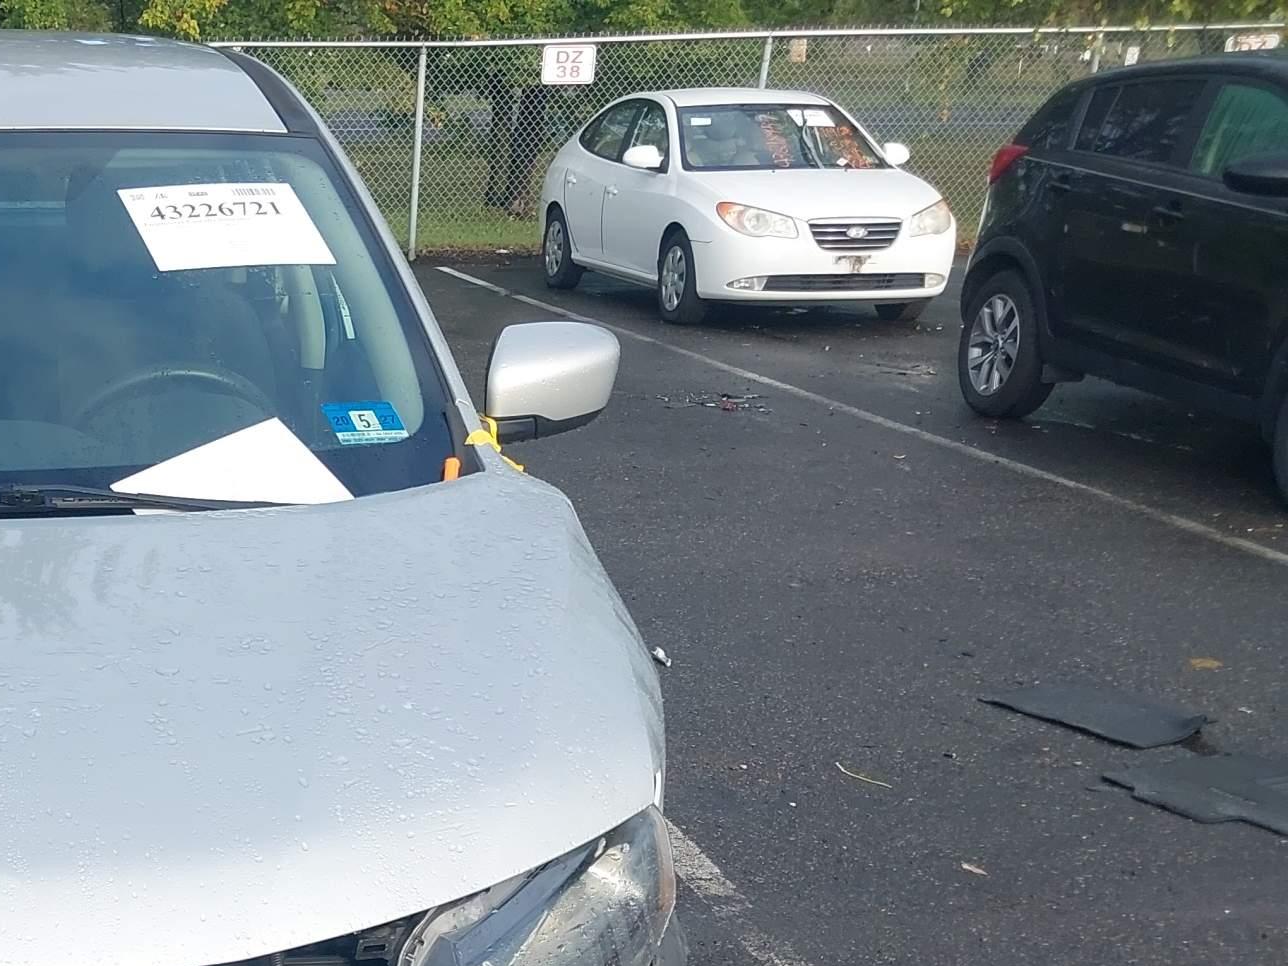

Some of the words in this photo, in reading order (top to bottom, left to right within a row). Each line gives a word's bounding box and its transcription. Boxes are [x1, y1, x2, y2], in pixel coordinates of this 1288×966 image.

[556, 50, 584, 64] DZ
[556, 65, 580, 78] 38
[150, 201, 282, 220] 43226721
[332, 415, 349, 426] 20
[357, 413, 371, 428] 5
